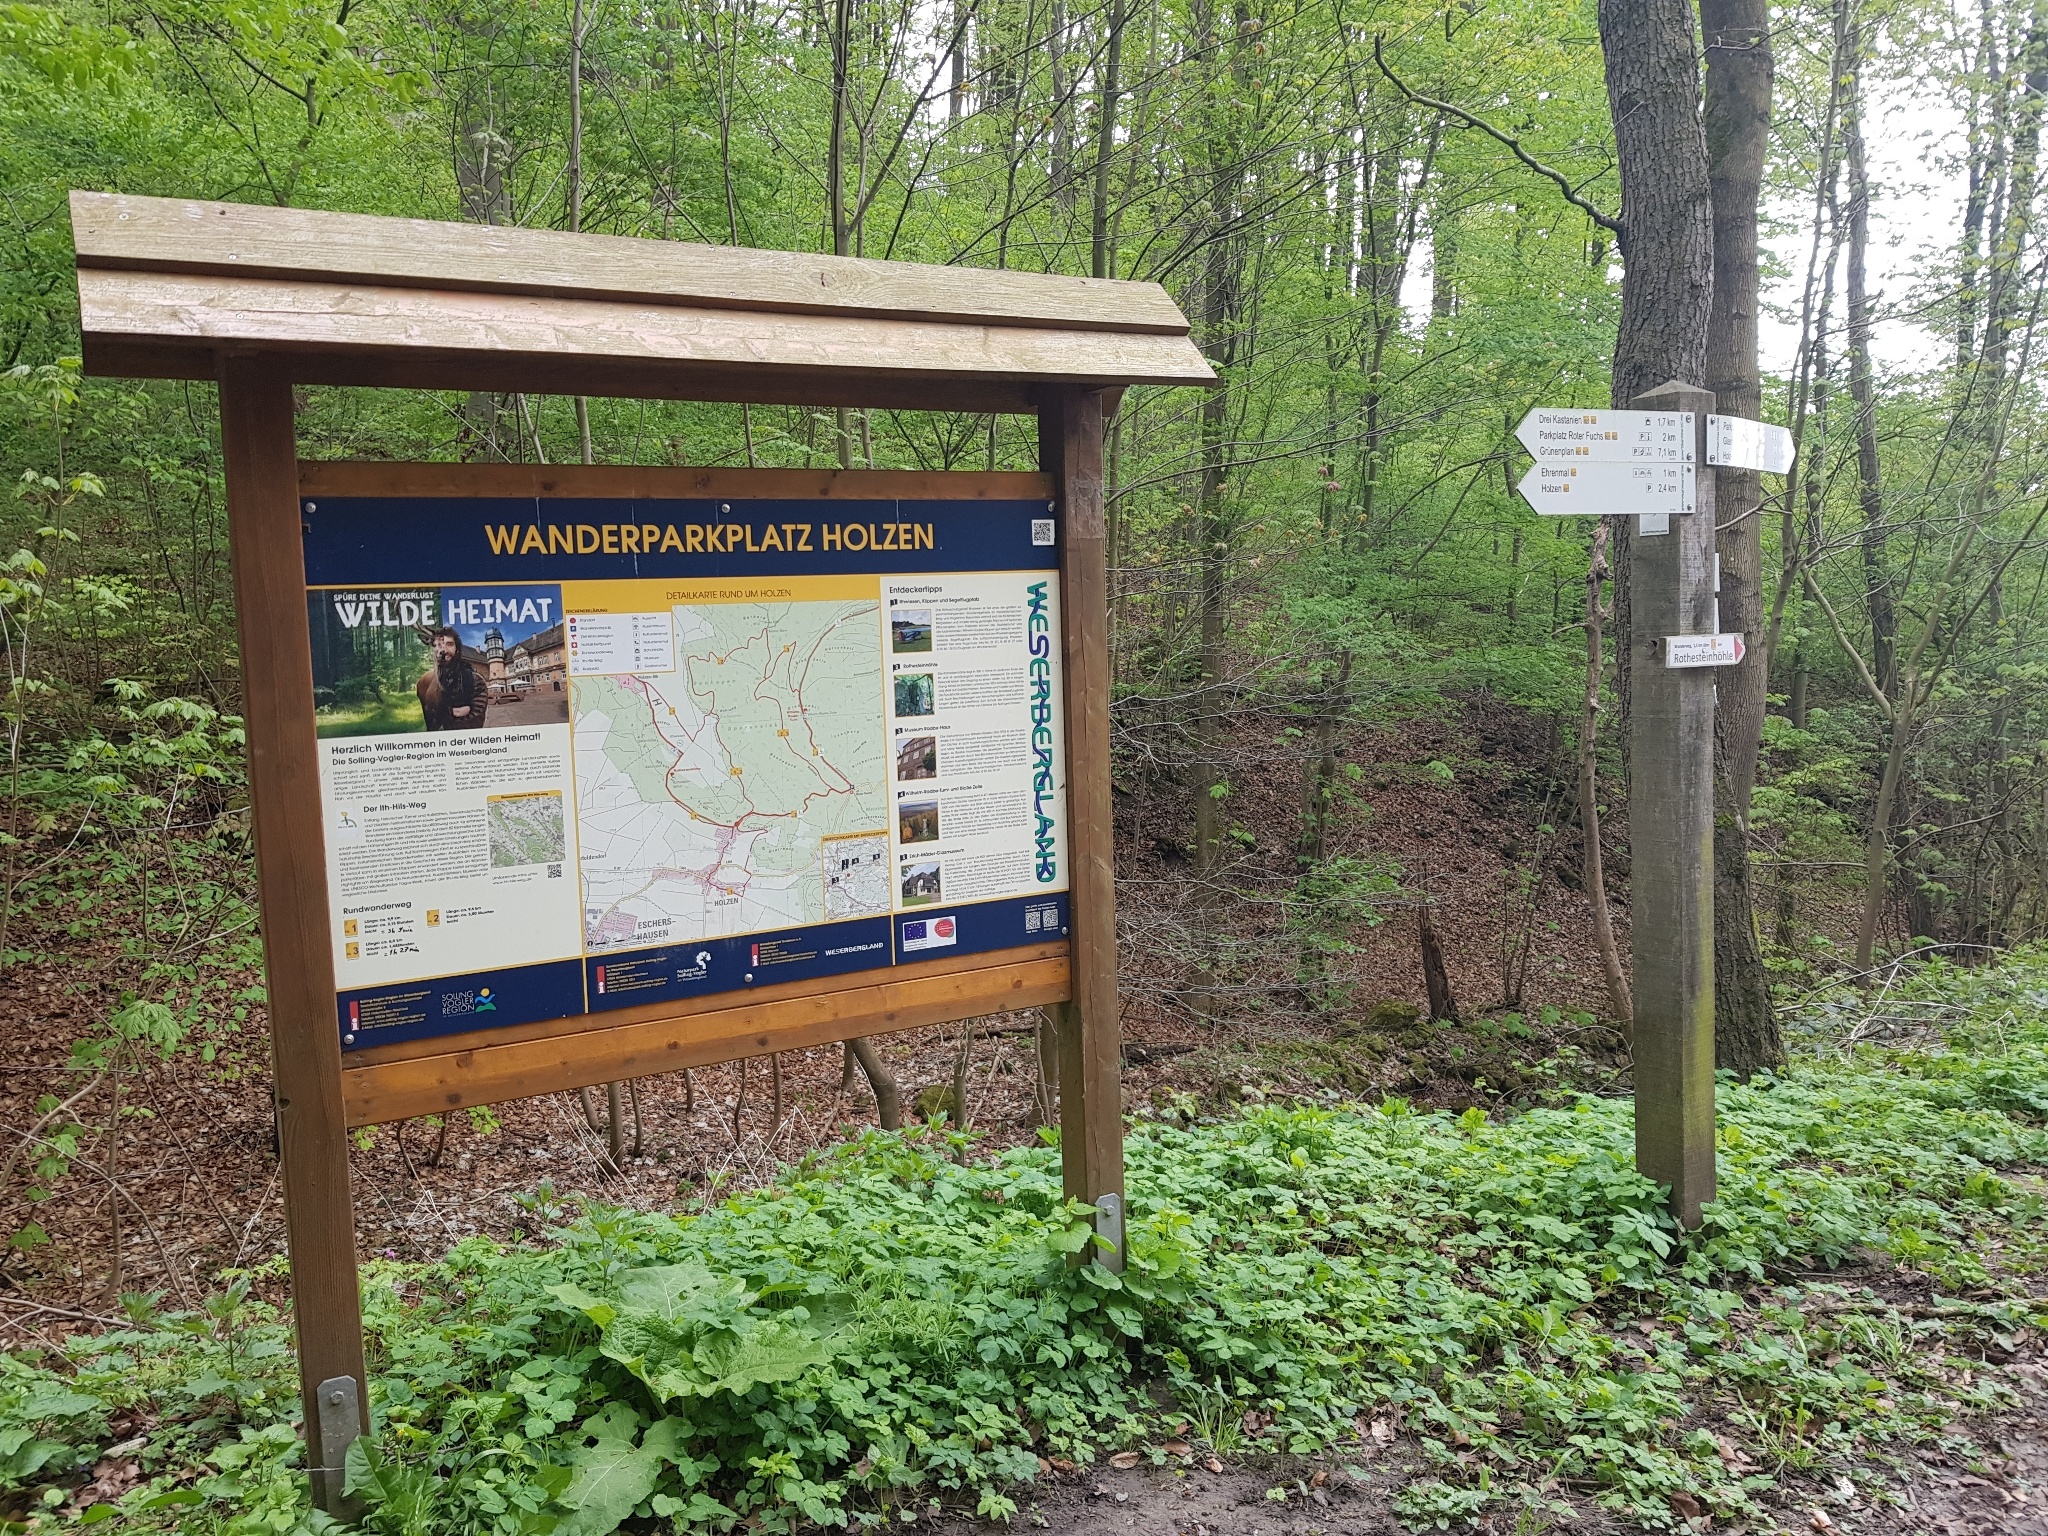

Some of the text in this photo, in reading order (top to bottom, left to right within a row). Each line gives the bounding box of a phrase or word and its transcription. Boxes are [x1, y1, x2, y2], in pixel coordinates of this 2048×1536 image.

[1539, 415, 1551, 424] Drei
[1553, 415, 1582, 424] Kastanien
[1667, 418, 1675, 426] km
[1540, 431, 1566, 441] Parkplatz
[1569, 432, 1584, 440] Roter
[1586, 432, 1603, 440] Fuchs
[1668, 433, 1676, 441] km
[1540, 447, 1574, 457] Grünenplan
[1658, 448, 1666, 457] 7,1
[1668, 448, 1676, 456] km
[1542, 468, 1569, 477] Ehrenmal
[1668, 469, 1676, 477] km
[1542, 484, 1562, 493] Holzen
[1658, 485, 1666, 493] 2,4
[1668, 484, 1676, 493] km
[485, 523, 934, 555] WANDERPARKPLATZ HOLZEN
[666, 589, 792, 600] DETAILKARTE RUND UM HOLZEN
[890, 586, 942, 594] Entdeckertipps
[334, 591, 434, 601] SPÜRE DEINE WANDERLUST
[335, 598, 552, 628] WILDE HEIMAT
[1674, 651, 1733, 663] Rothesteinhöhle
[1027, 581, 1057, 883] WESERBERGLAND
[332, 733, 541, 754] Herzlich Willkommen in der Wilden Heimat!
[348, 751, 434, 764] Solling-Vogler-Region
[449, 747, 507, 757] Weserbergland
[380, 802, 426, 811] Ith-Hils-Weg
[343, 901, 411, 914] Rundwanderweg
[714, 897, 738, 907] HOLZEN
[638, 918, 676, 929] ESCHERS-
[637, 929, 669, 940] HAUSEN
[825, 942, 884, 956] WESERBERGLAND
[442, 991, 474, 1000] SOLLING
[442, 998, 474, 1007] VOGLER
[442, 1004, 474, 1014] REGION
